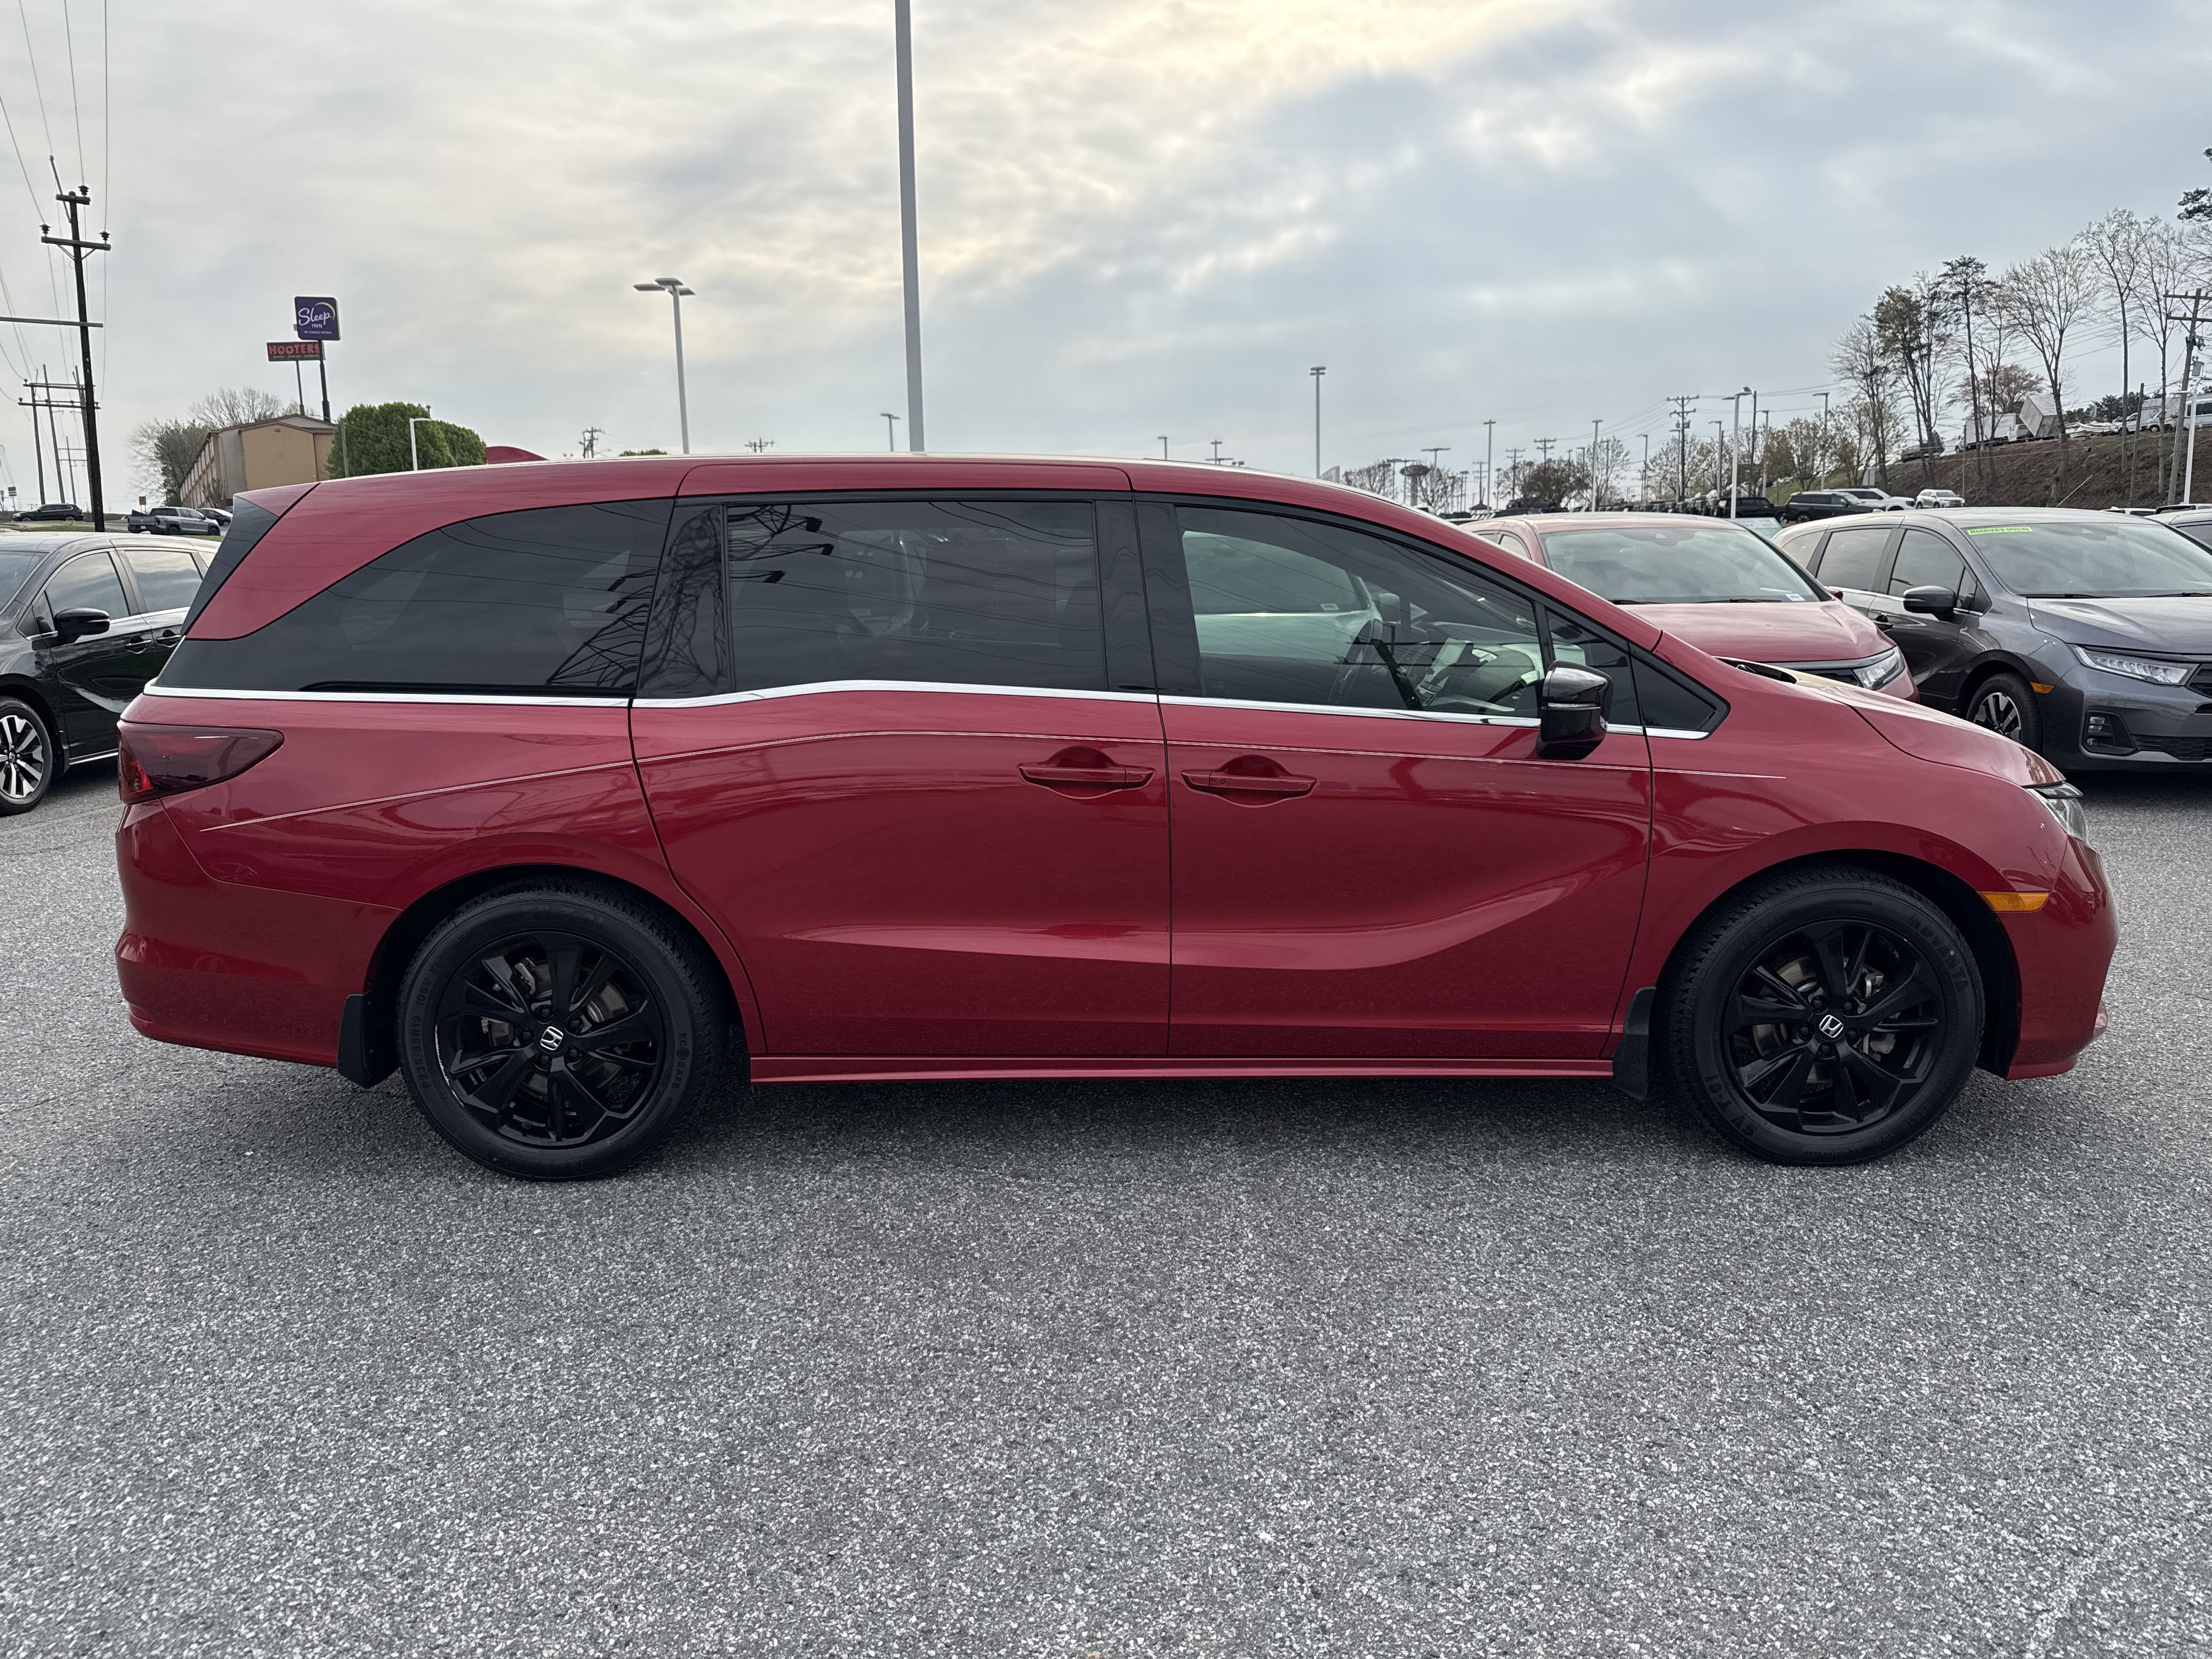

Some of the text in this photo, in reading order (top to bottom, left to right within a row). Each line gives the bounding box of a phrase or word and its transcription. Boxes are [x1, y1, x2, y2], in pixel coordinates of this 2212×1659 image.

[298, 307, 332, 325] Sleep
[268, 343, 319, 355] HOOTERS
[413, 1015, 431, 1089] P235/55R19
